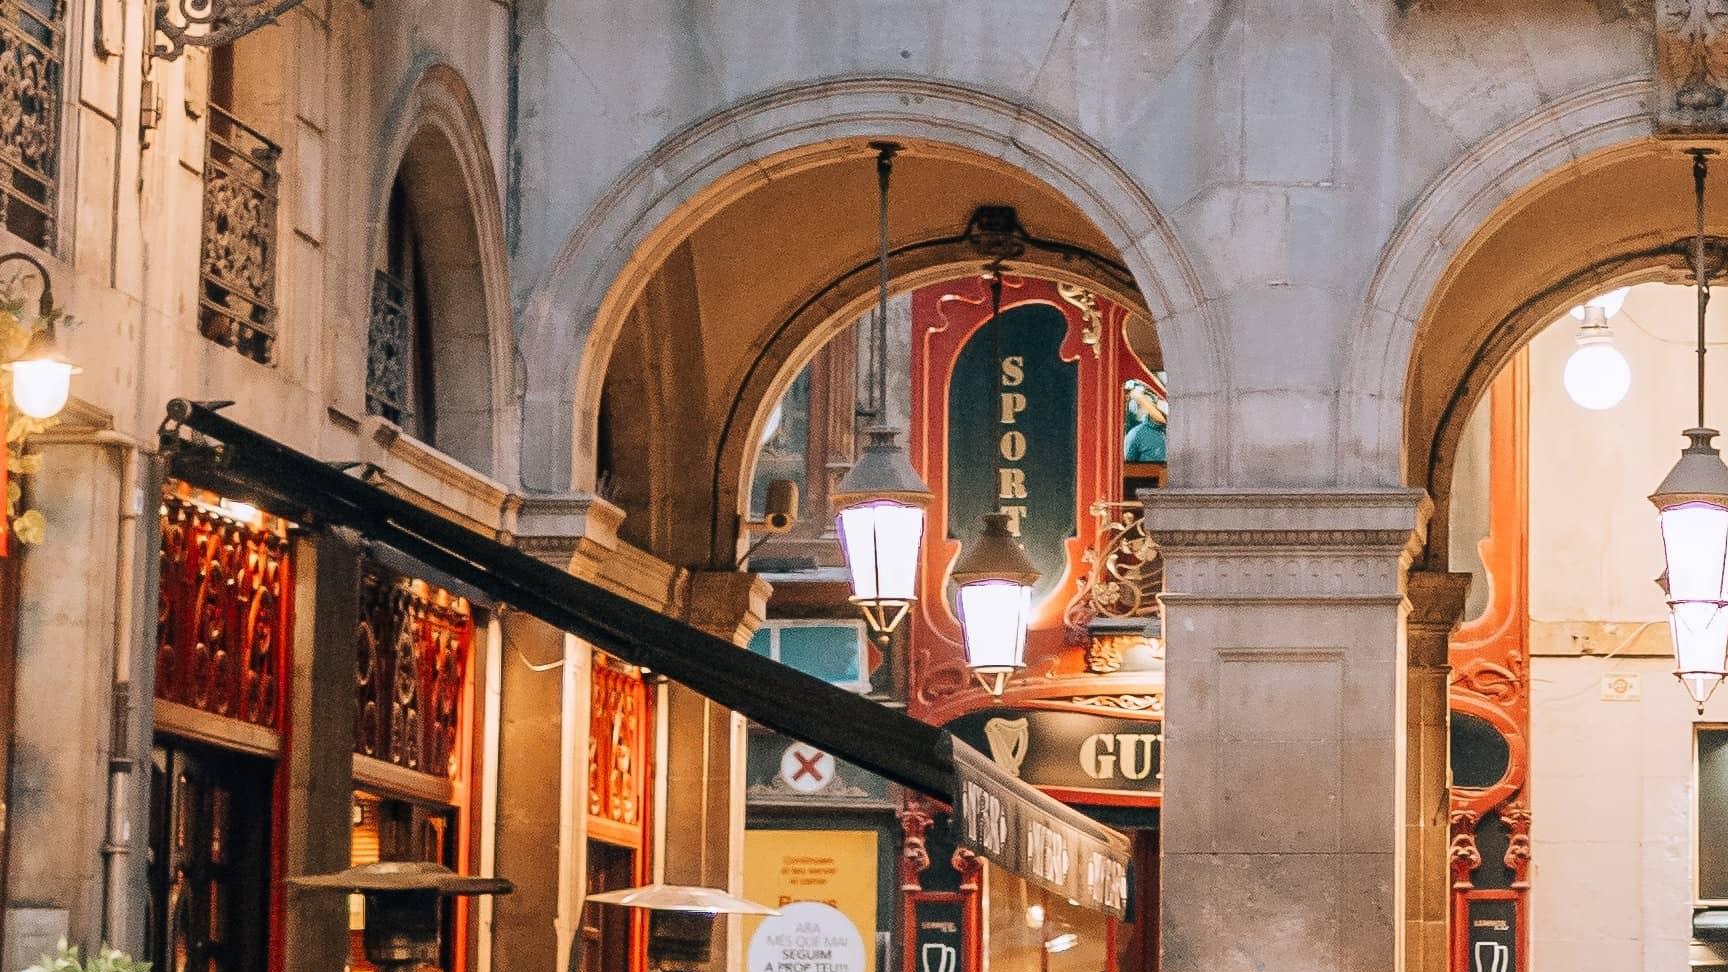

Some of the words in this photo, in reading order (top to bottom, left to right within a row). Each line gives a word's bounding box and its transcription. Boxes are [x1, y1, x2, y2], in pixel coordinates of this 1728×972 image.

[1079, 733, 1161, 780] GU
[782, 949, 832, 960] SEGUIM
[764, 961, 774, 972] A
[778, 962, 811, 972] PROP
